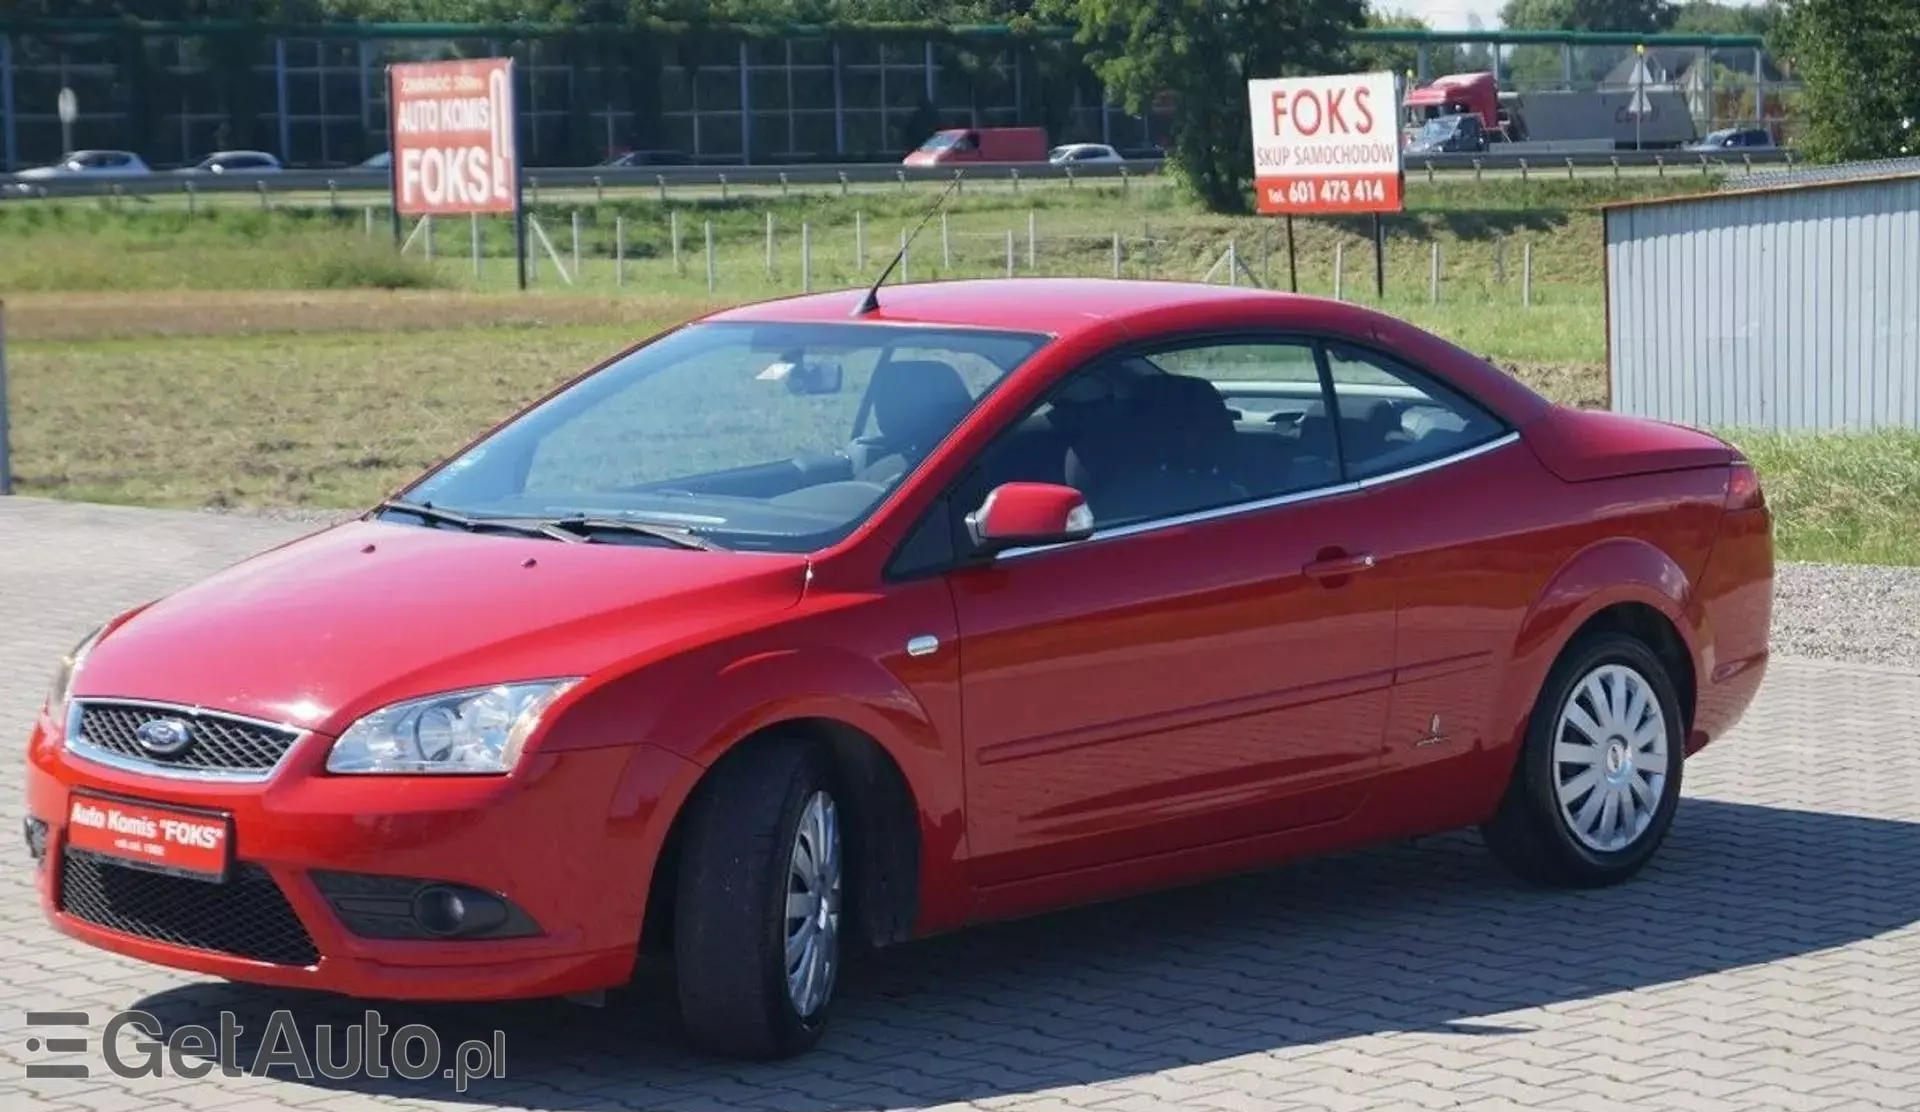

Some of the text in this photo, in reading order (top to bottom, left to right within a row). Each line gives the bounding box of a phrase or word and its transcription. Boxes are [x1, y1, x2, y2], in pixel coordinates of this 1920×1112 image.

[398, 97, 490, 132] AUTO KOMIS
[1271, 86, 1373, 136] FOKS
[1257, 141, 1394, 167] SKUP SAMOCHODÓW
[402, 146, 490, 205] FOKS
[1288, 180, 1317, 204] 601
[1320, 179, 1351, 203] 473
[1354, 178, 1385, 202] 414
[71, 802, 106, 829] Auto
[107, 810, 157, 839] Komis
